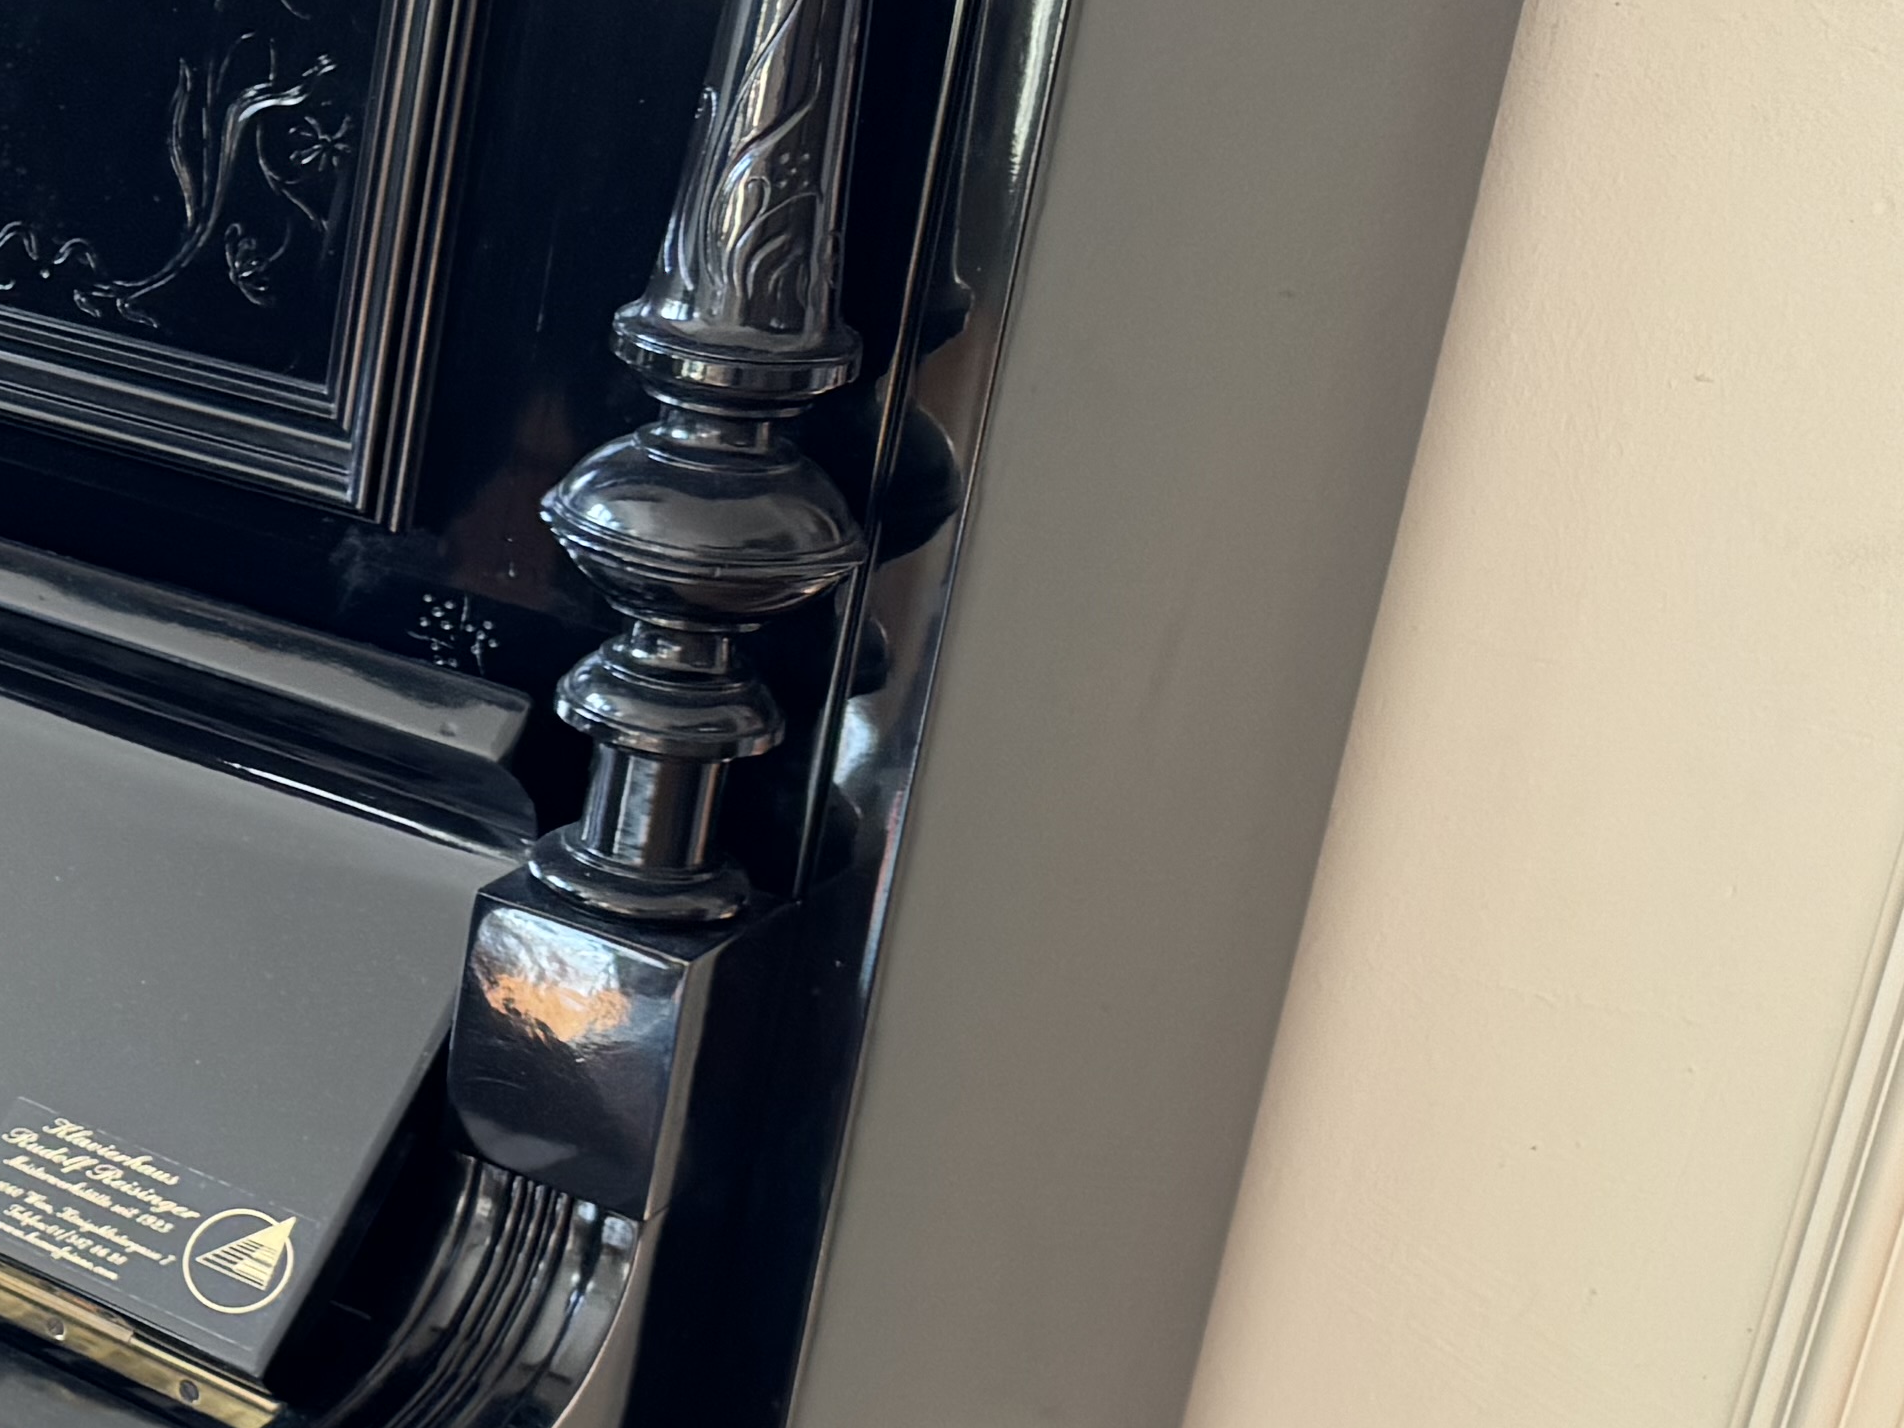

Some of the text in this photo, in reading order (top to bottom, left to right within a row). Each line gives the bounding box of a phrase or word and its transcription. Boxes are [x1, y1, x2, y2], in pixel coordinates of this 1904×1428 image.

[1, 1127, 201, 1219] Rudolf Reisinger
[42, 1117, 180, 1186] Klavierhaus
